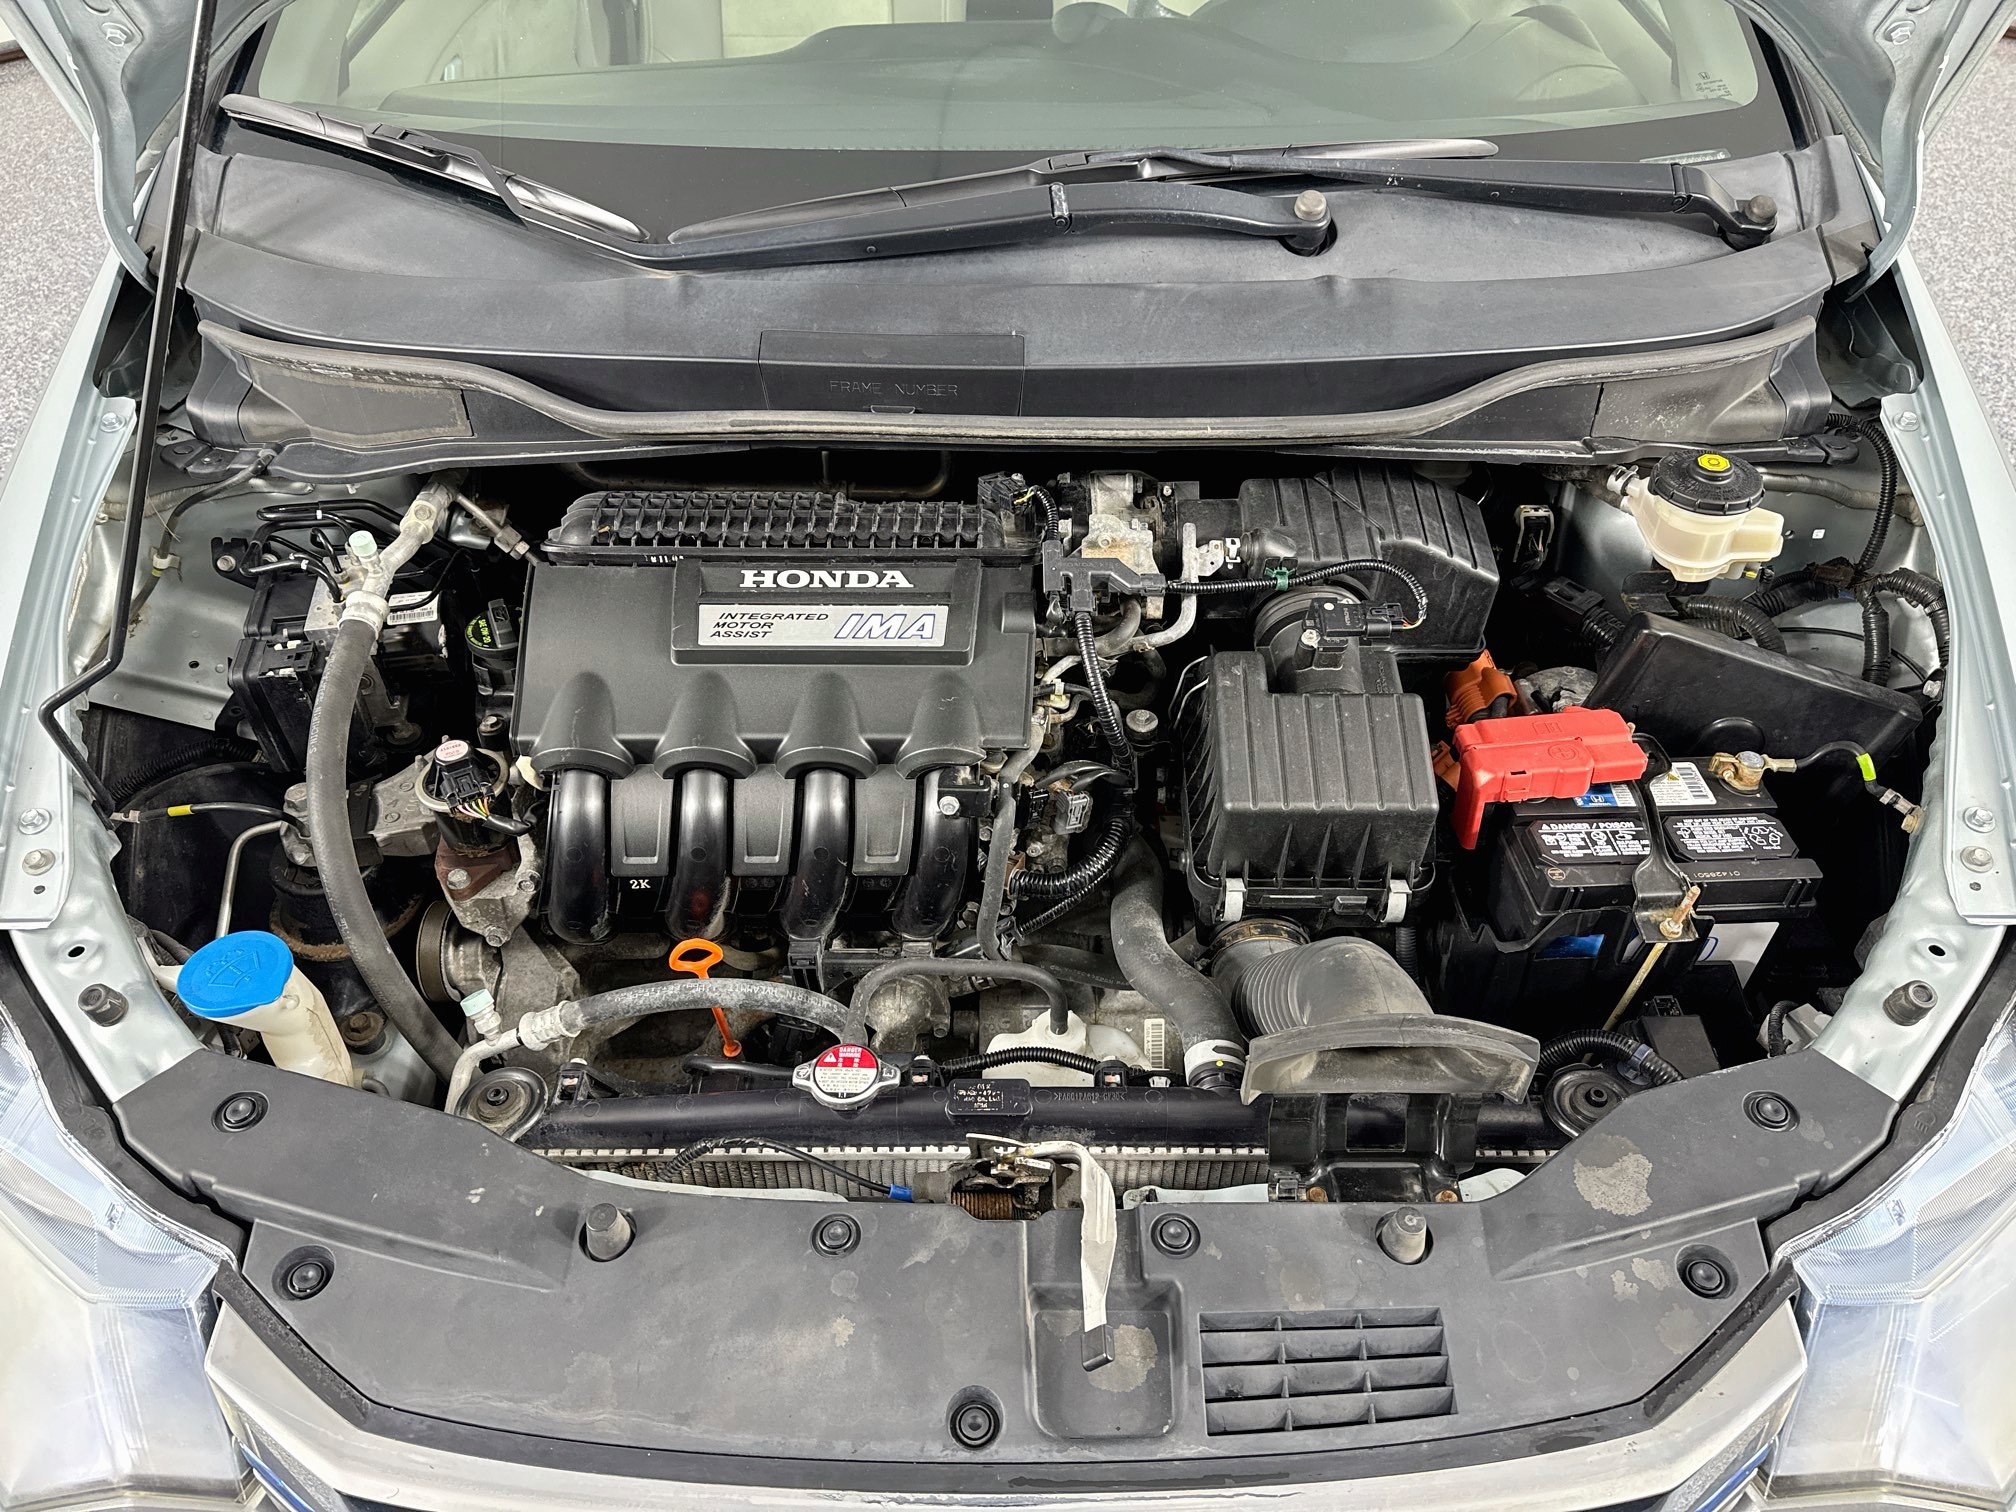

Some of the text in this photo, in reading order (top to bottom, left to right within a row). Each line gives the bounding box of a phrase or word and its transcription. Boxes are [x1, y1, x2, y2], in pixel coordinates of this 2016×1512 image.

[829, 380, 958, 396] FRAME NUMBER
[739, 569, 914, 588] HONDA
[718, 612, 829, 621] INTEGRATED
[712, 621, 774, 629] MOTOR
[834, 613, 936, 639] IMA
[710, 630, 772, 638] ASSIST
[1550, 822, 1591, 831] DANGER
[1599, 821, 1636, 830] POISON
[629, 879, 652, 889] 2K
